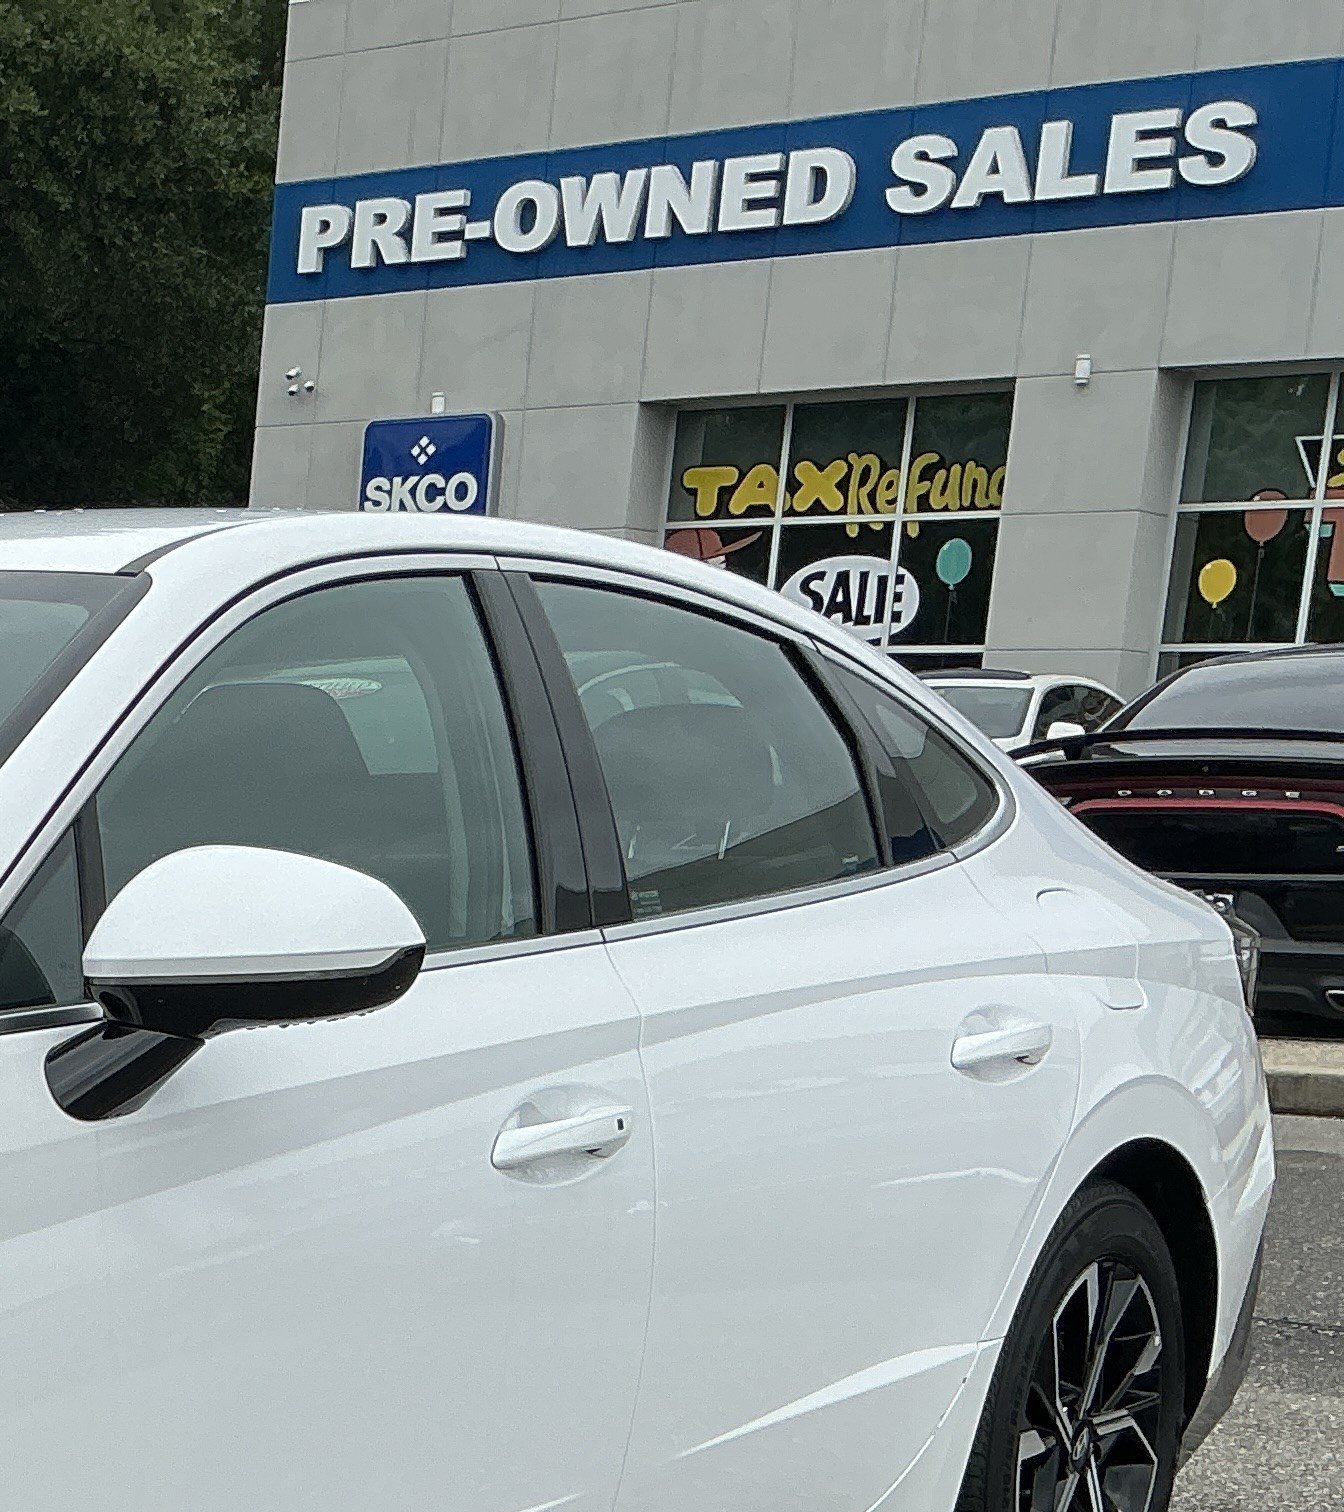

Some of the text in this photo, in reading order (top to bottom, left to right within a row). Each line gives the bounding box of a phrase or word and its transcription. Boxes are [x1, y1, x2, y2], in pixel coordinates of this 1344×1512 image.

[295, 99, 1260, 275] PRE-OWNED SALES
[363, 471, 478, 513] SKCO
[682, 459, 849, 518] TAX
[799, 569, 906, 627] SALE
